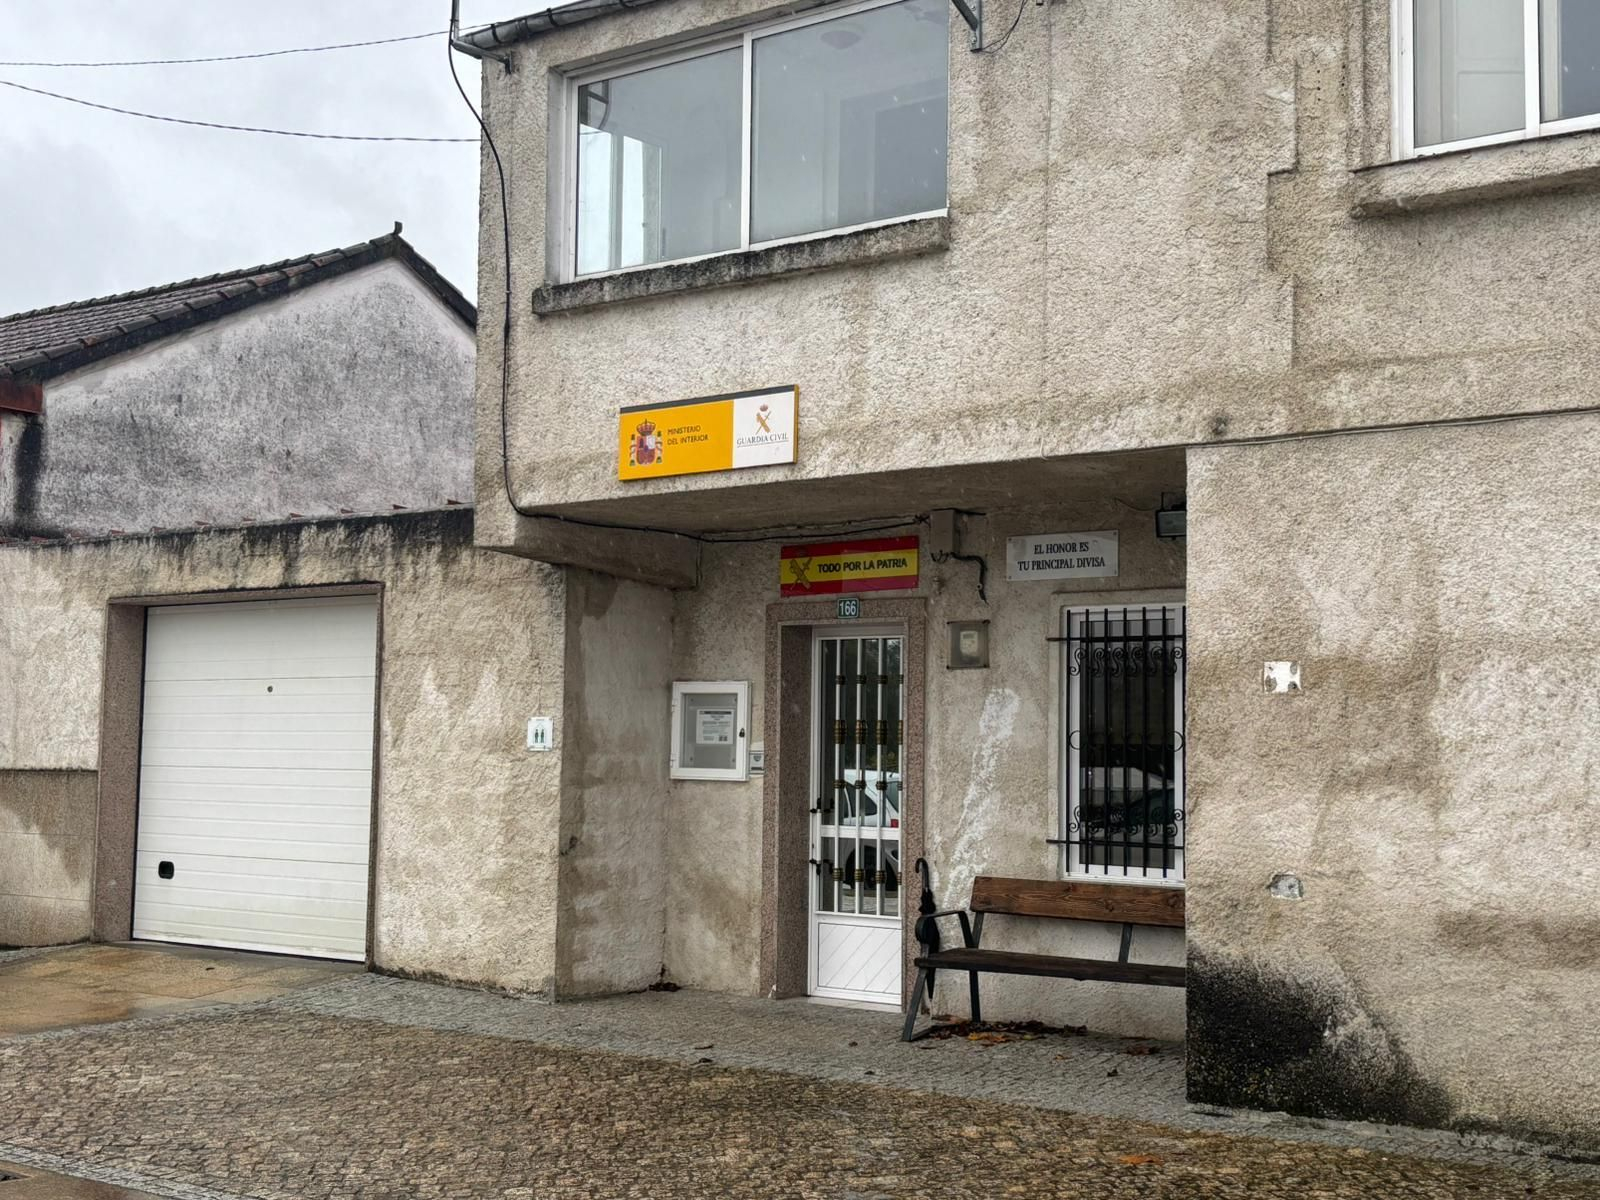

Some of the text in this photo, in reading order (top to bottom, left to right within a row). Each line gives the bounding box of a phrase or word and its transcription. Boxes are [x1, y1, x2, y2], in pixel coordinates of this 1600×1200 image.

[667, 425, 701, 435] MINISTERIO
[667, 434, 709, 446] DEL INTERIOR
[737, 432, 789, 446] GUARDIA CIVIL
[1034, 541, 1089, 555] EL HONOR ES
[818, 557, 908, 573] TODO POR LA PATRIA
[1018, 556, 1106, 571] TU PRINCIPAL DIVISA
[839, 601, 857, 616] 166
